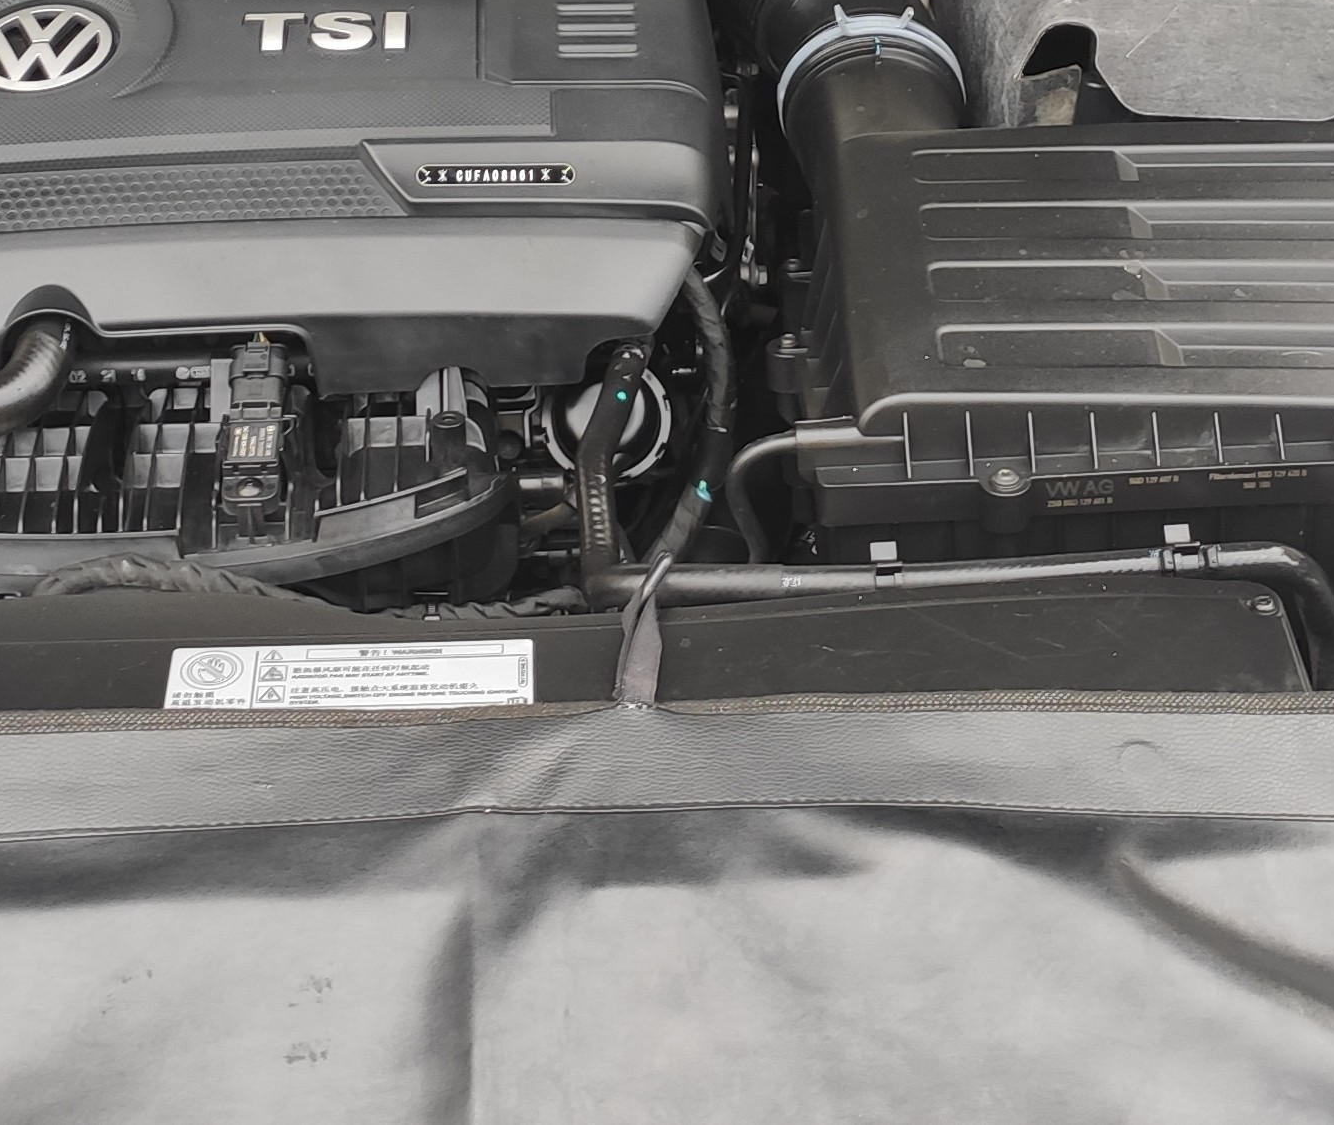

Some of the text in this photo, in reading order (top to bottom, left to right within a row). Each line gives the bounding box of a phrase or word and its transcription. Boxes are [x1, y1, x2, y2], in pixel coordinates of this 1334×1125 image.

[244, 11, 408, 51] TSI
[1045, 481, 1080, 496] VW
[1083, 478, 1114, 494] AG
